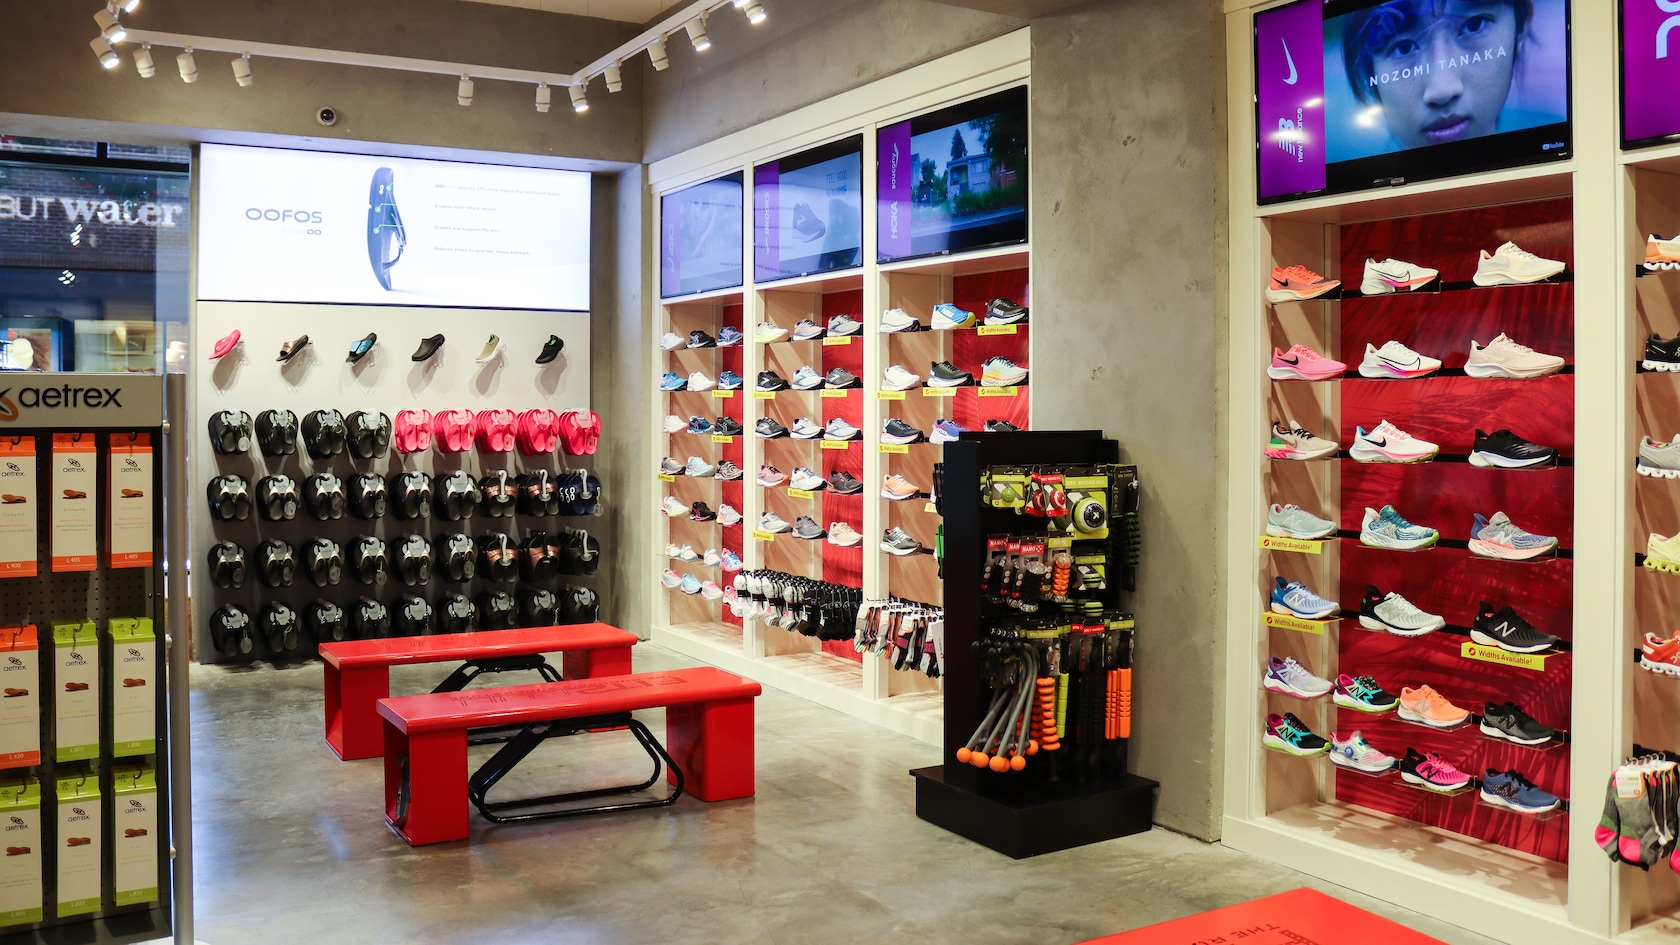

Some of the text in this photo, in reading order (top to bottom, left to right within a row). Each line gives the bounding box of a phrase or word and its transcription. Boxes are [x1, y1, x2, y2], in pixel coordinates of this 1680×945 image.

[1369, 45, 1507, 88] NOZOMI TANAKA
[60, 198, 184, 228] water
[245, 208, 322, 223] OOFOS
[890, 201, 898, 240] HOKA
[18, 383, 122, 409] aetrex
[1, 470, 25, 478] aetrex
[120, 466, 142, 474] aetrex
[1271, 540, 1313, 551] Widths Available!
[1289, 593, 1306, 607] N
[1273, 617, 1315, 631] Widths Available!
[1494, 621, 1516, 638] N
[1478, 649, 1532, 667] Widths Available!
[124, 807, 146, 815] aetrex
[67, 814, 90, 823] aetrex
[5, 824, 28, 832] aetrex
